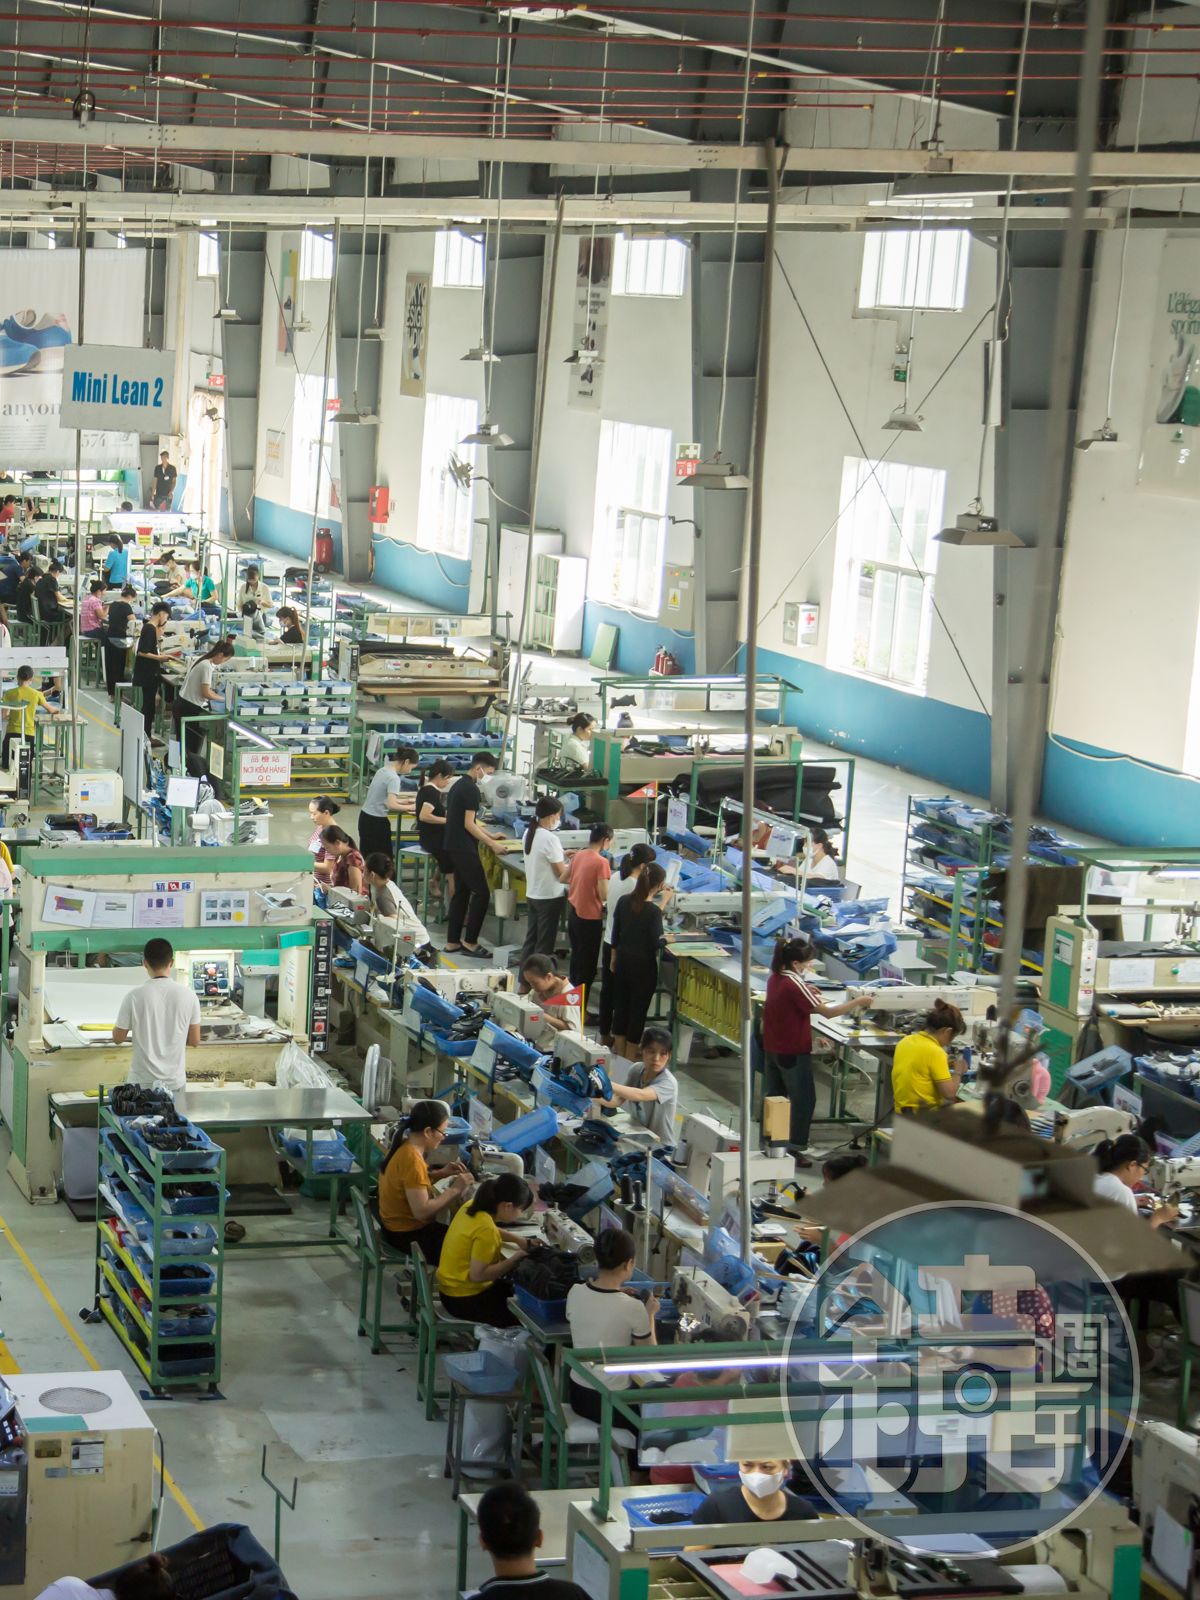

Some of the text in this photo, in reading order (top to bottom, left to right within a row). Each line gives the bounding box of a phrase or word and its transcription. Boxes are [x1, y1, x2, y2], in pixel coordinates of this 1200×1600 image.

[71, 371, 164, 408] Mini Lean 2
[2, 401, 61, 423] anyon
